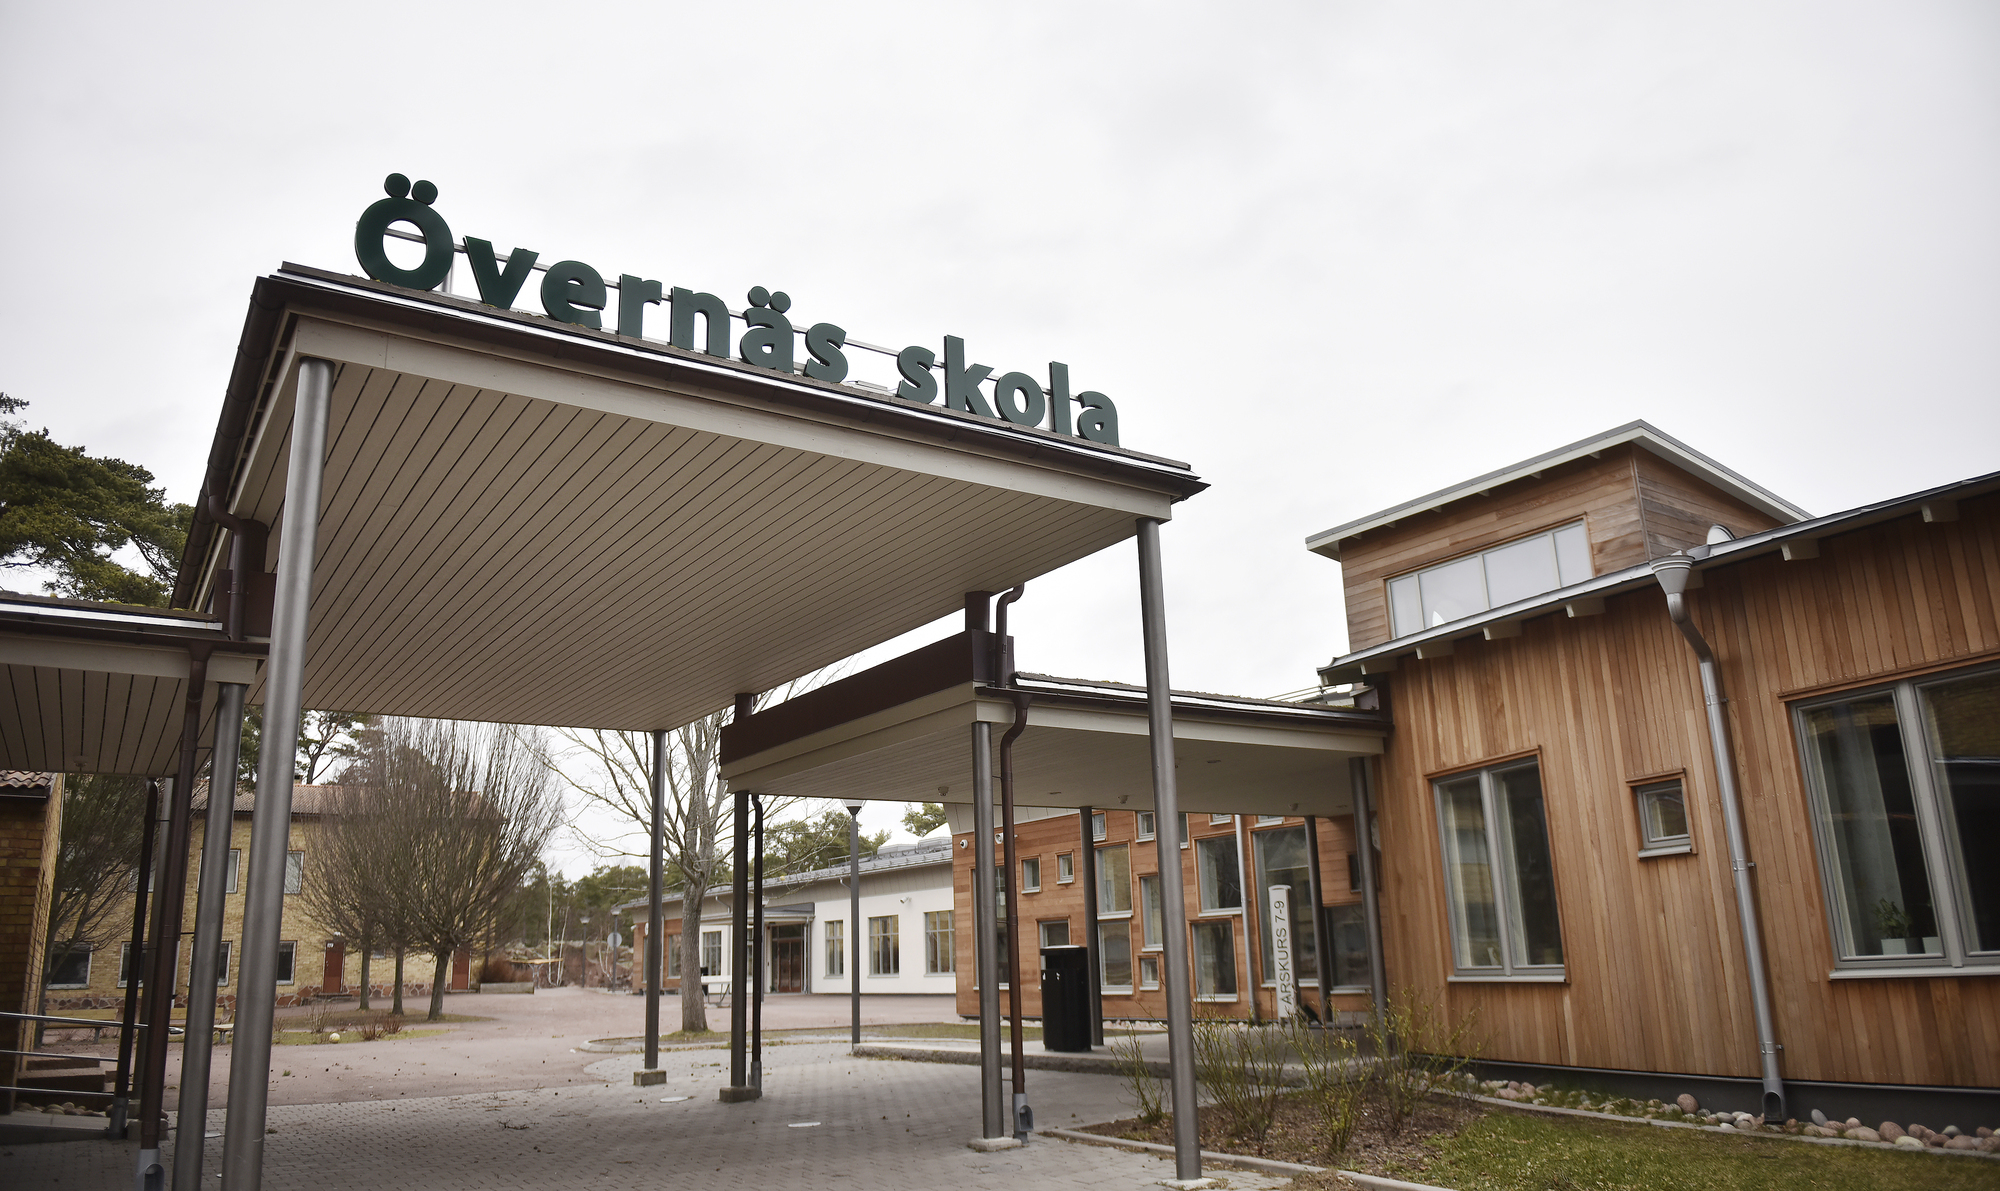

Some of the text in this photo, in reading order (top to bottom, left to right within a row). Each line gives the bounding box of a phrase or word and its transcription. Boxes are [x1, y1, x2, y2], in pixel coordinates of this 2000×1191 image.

[354, 172, 1119, 446] Övernäs skola
[1274, 900, 1286, 923] 7-9
